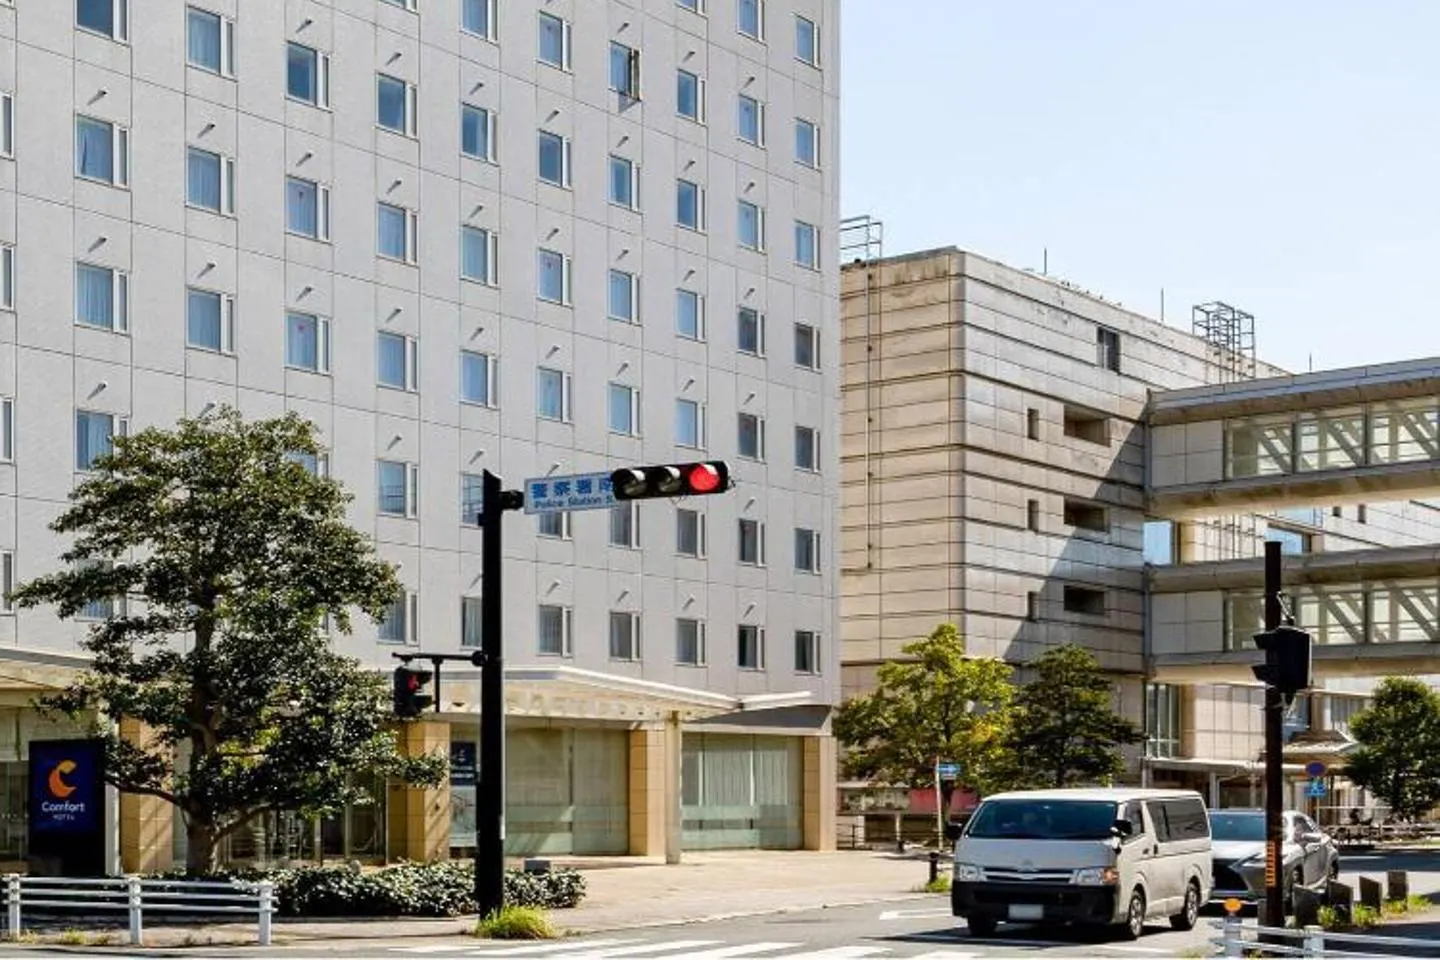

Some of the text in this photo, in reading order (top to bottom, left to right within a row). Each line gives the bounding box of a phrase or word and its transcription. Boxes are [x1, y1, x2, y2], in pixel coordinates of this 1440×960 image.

[534, 498, 564, 509] Police
[568, 495, 602, 506] Station
[41, 799, 86, 813] Comfort
